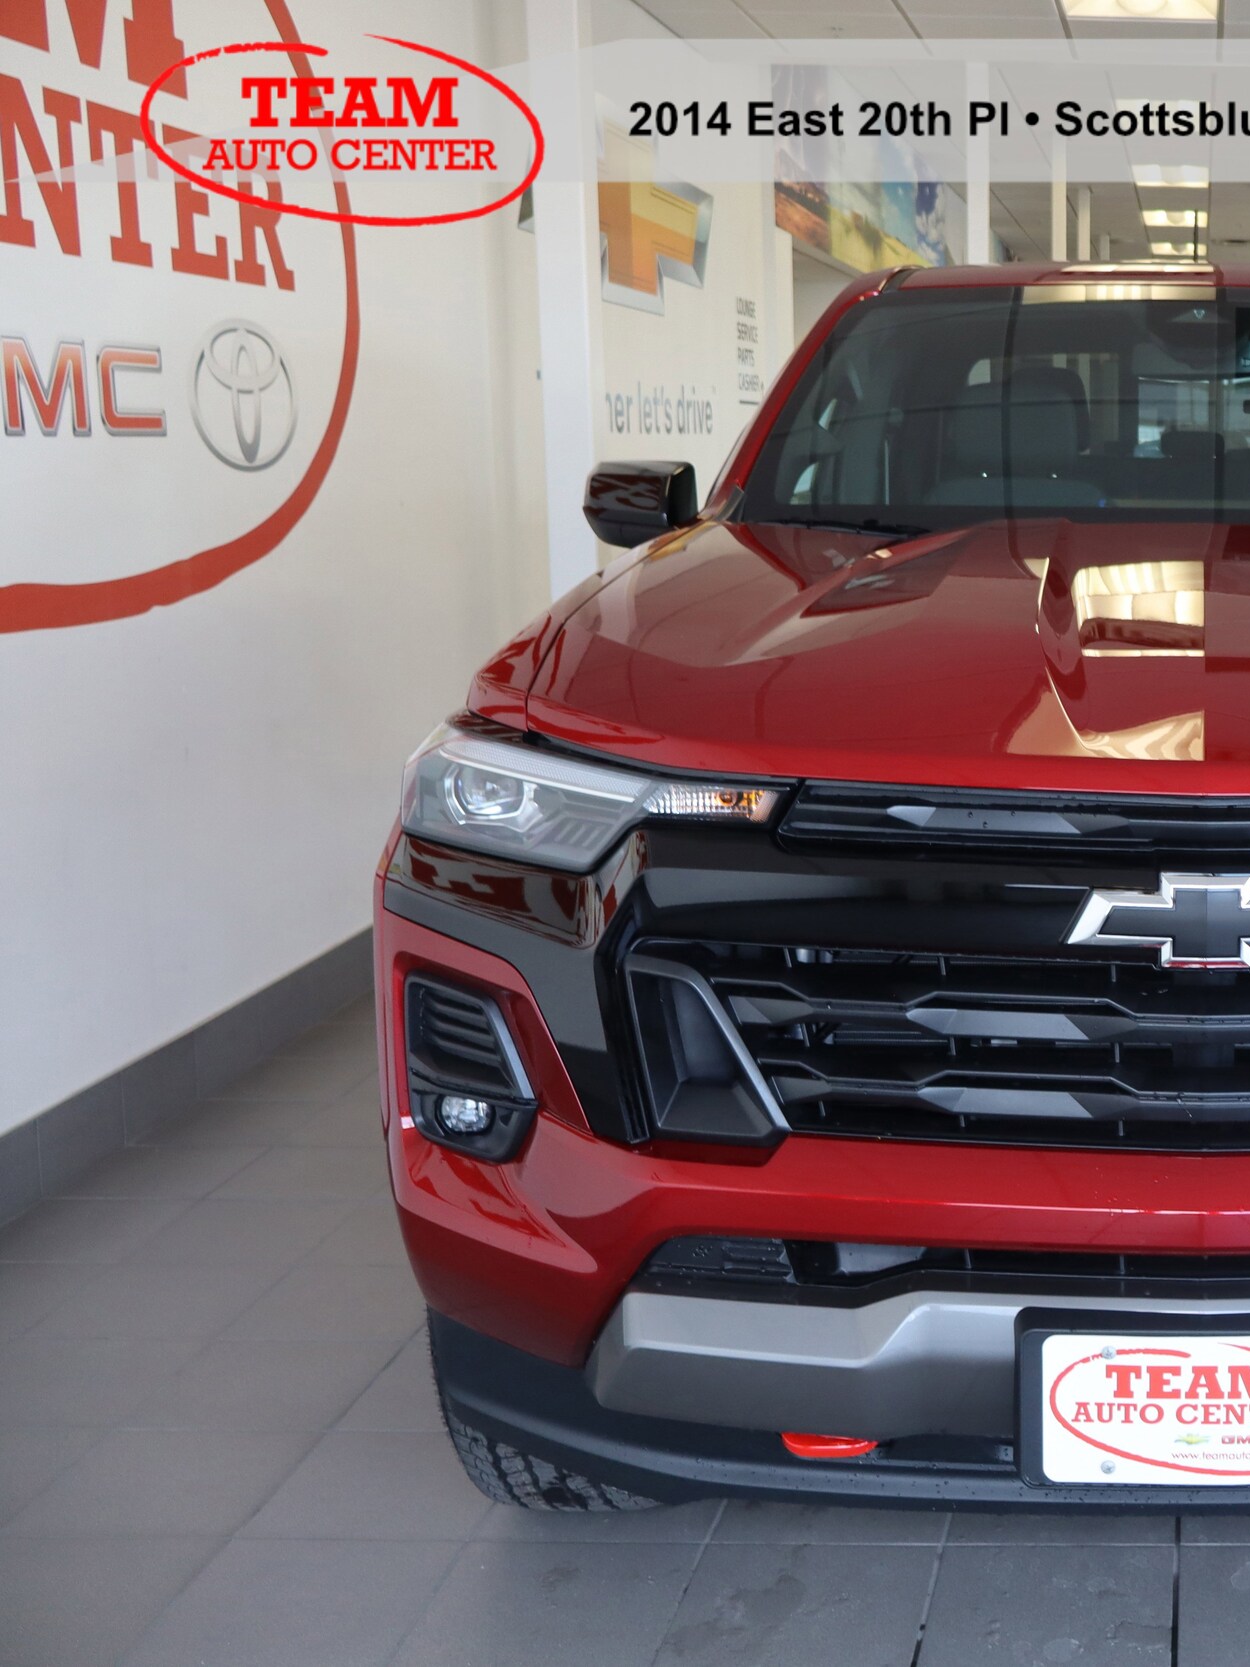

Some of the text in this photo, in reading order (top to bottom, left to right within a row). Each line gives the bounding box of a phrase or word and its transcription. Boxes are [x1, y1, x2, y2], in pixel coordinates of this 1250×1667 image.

[736, 320, 759, 344] SERVICE
[637, 381, 674, 435] let's
[676, 384, 714, 435] drive
[1070, 1401, 1165, 1425] AUTO
